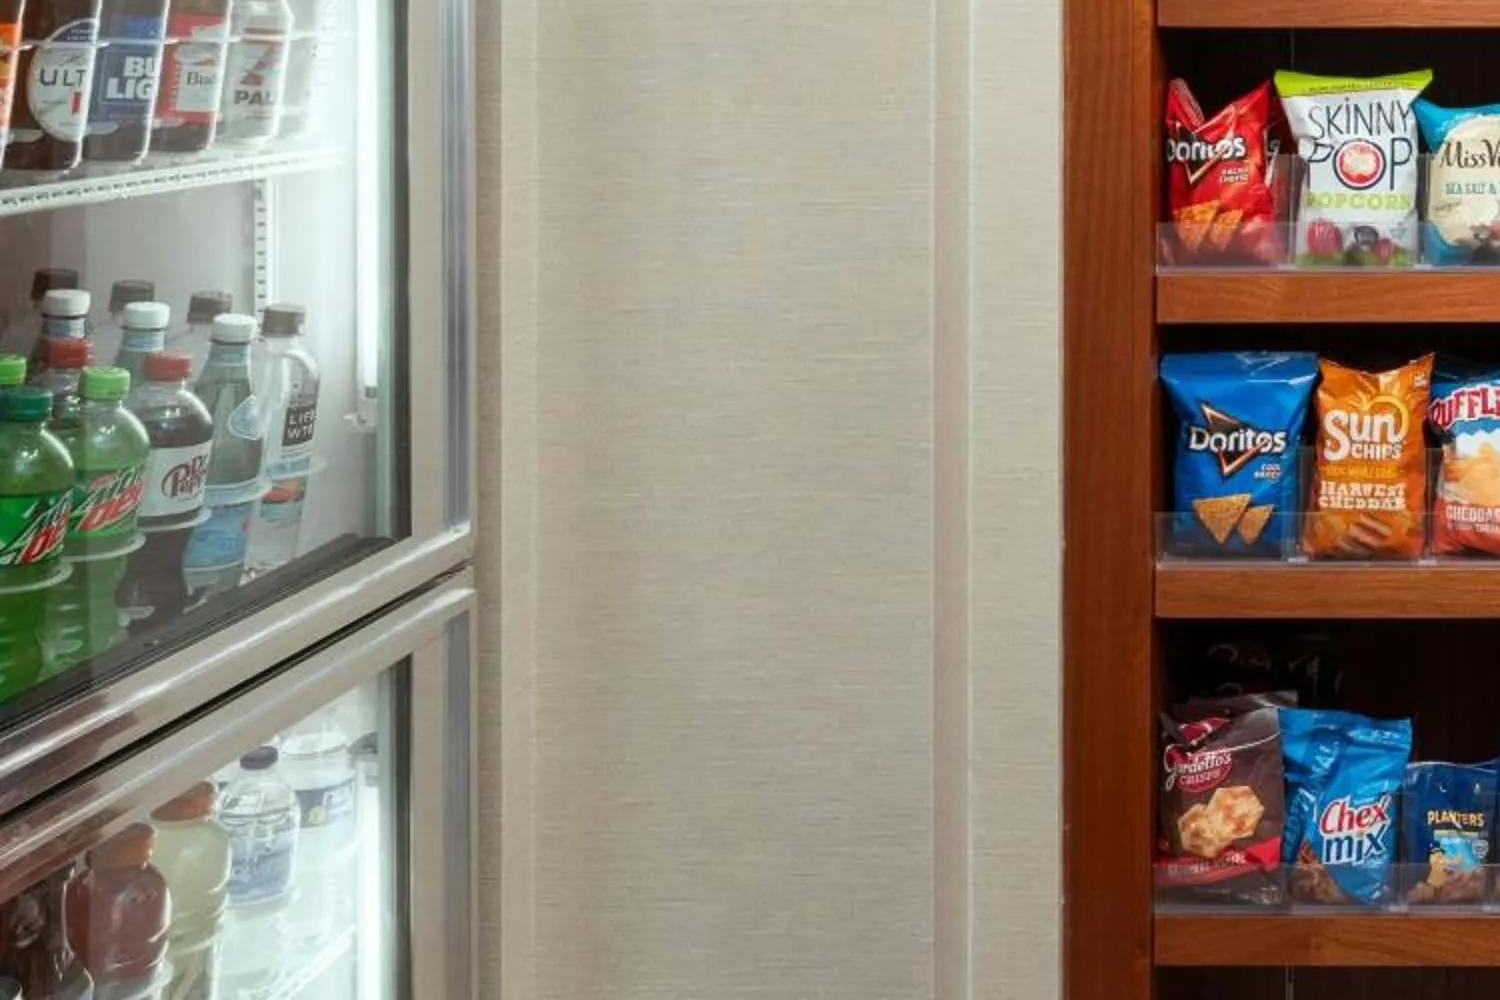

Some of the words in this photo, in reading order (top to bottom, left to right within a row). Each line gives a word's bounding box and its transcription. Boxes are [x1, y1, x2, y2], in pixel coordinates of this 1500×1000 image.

[39, 67, 87, 87] ULT
[123, 56, 157, 77] BU
[105, 77, 154, 99] LIG
[1308, 96, 1412, 140] SKINNY
[1307, 136, 1413, 191] POP
[1440, 140, 1485, 169] Miss
[1189, 424, 1288, 453] Doritos
[1350, 443, 1403, 461] CHIPS
[1320, 480, 1407, 497] HARVEST
[1318, 495, 1407, 512] CHEDDAR
[1319, 796, 1392, 836] Chex
[1427, 810, 1485, 827] PLANTERS
